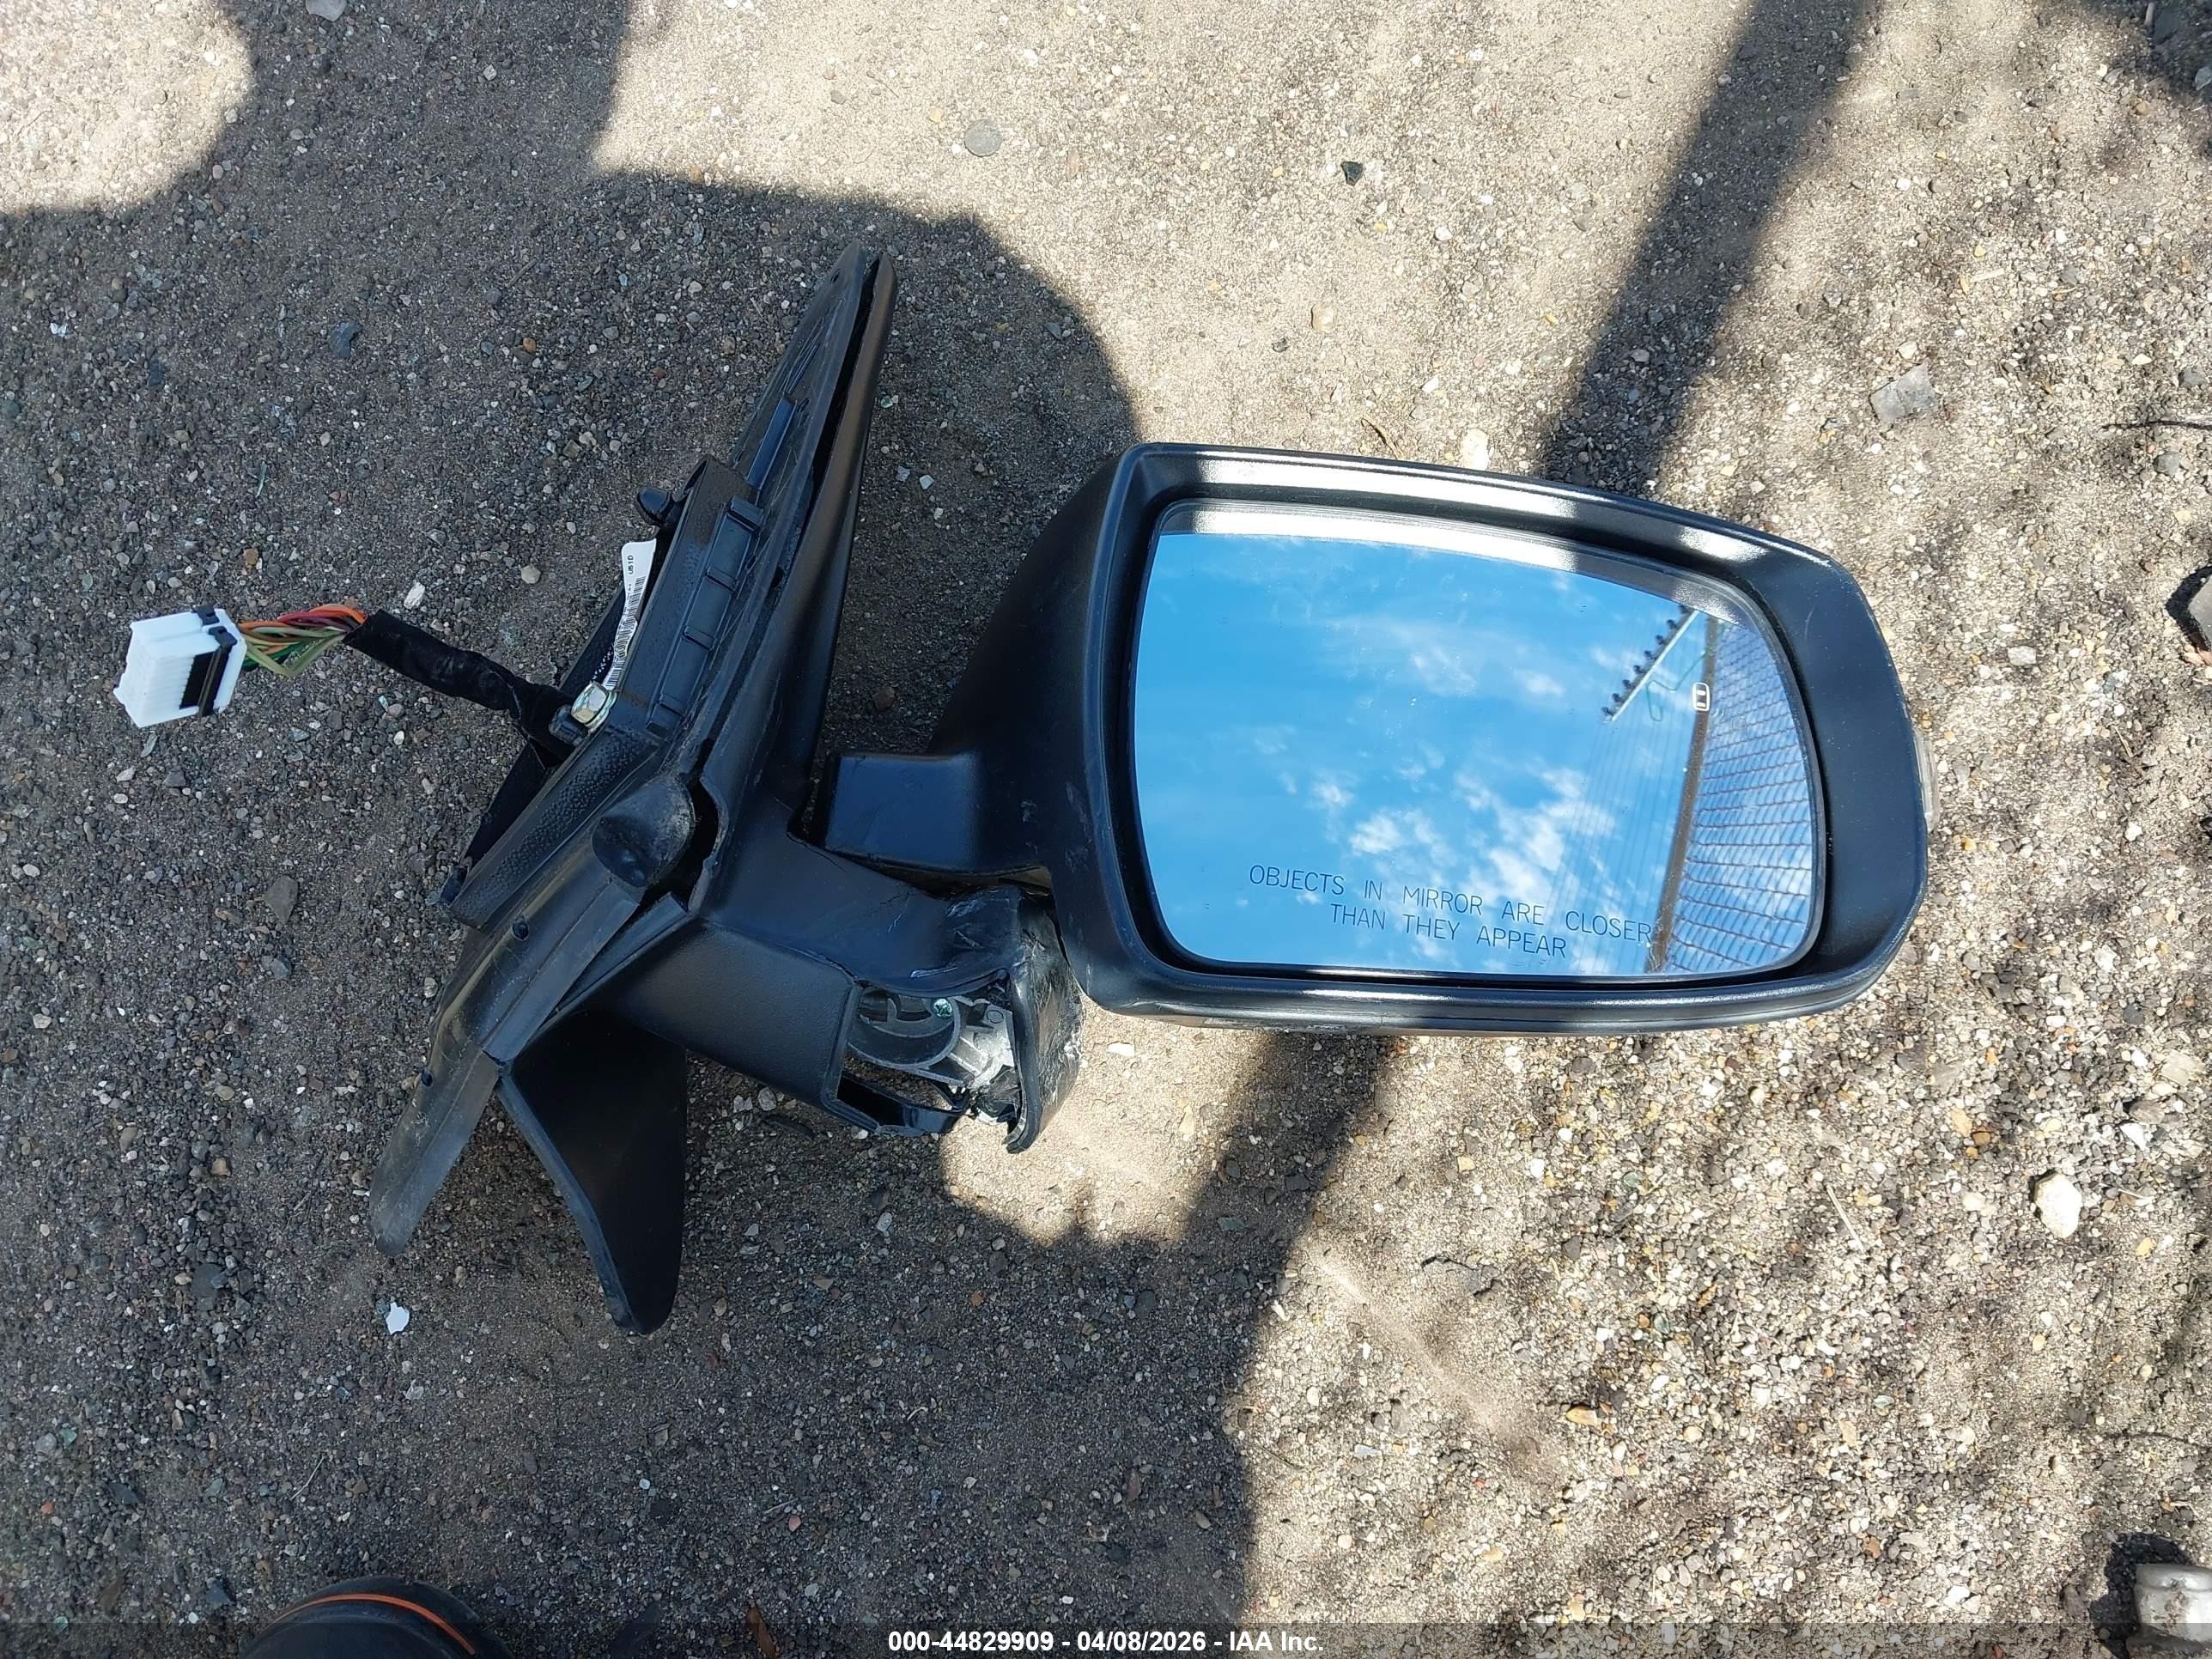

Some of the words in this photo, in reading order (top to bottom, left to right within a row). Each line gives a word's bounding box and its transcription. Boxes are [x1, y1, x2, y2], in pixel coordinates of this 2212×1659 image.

[1249, 864, 1345, 896] OBJECTS
[1364, 879, 1382, 901] IN
[1402, 885, 1483, 916] MIRROR
[1501, 900, 1545, 926] ARE
[1565, 910, 1651, 943] CLOSER
[1330, 903, 1386, 931] THAN
[1401, 914, 1461, 942] THEY
[1475, 926, 1567, 958] APPEAR
